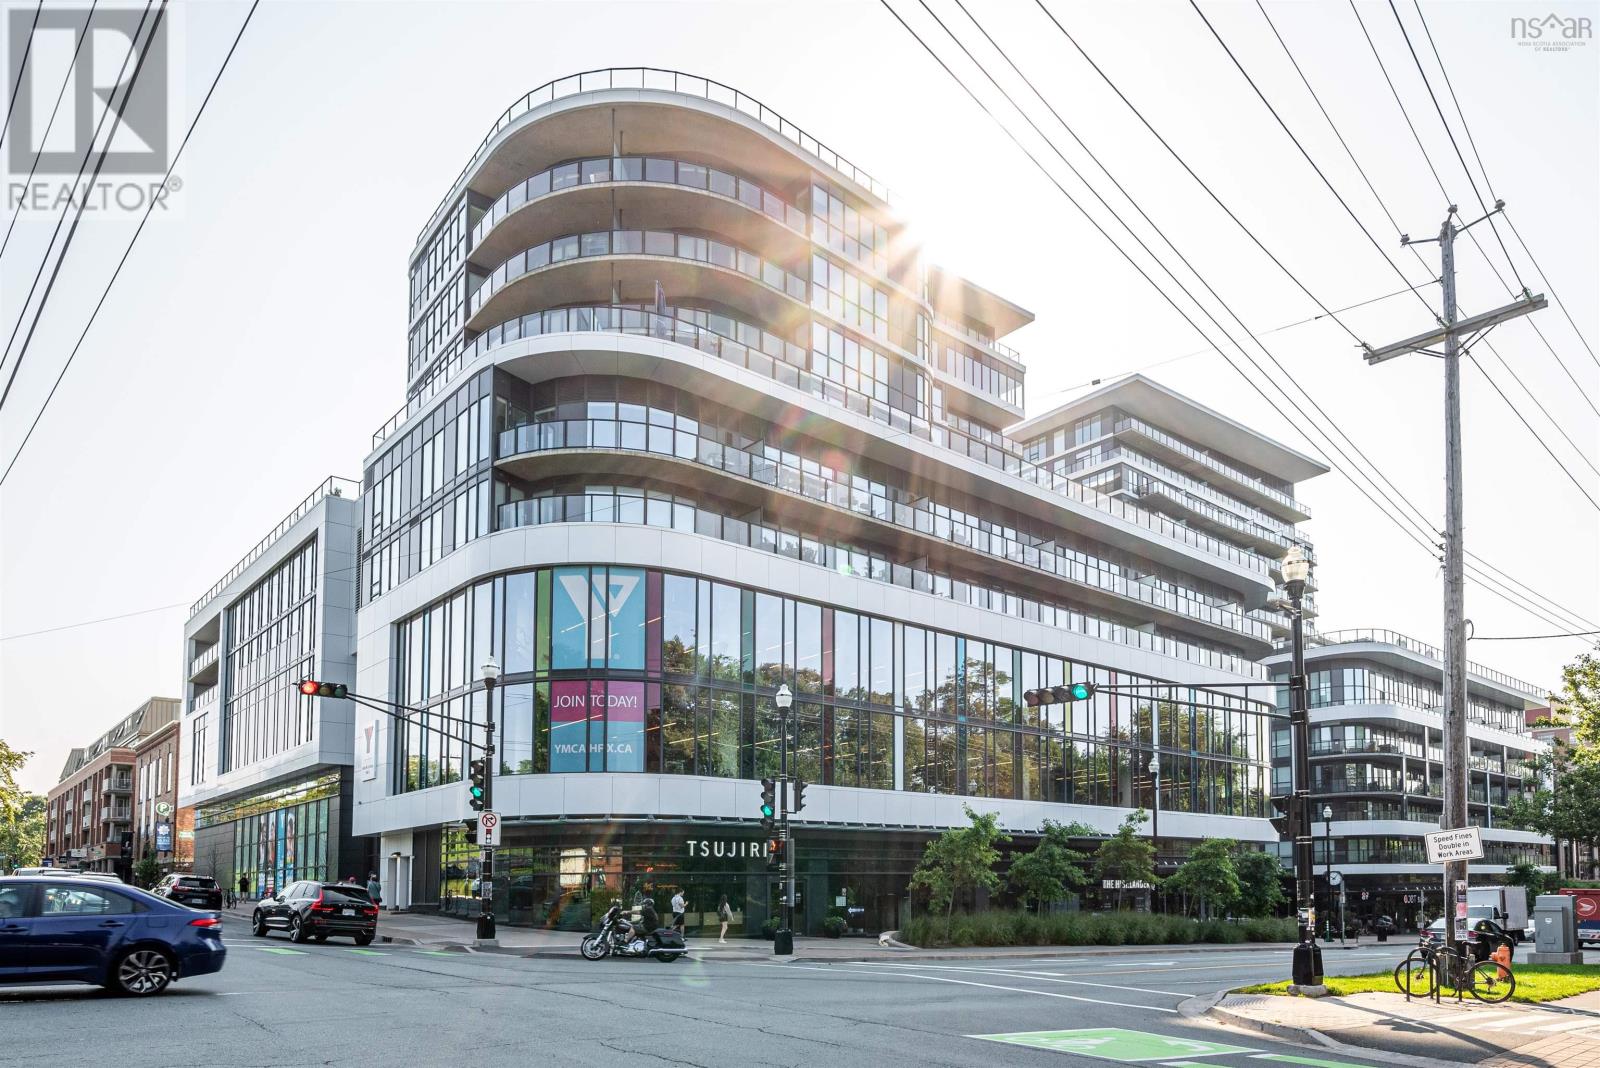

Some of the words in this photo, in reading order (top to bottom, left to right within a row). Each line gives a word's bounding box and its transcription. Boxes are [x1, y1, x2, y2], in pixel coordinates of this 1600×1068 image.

[553, 695, 585, 708] JOIN
[590, 694, 637, 708] TODAY!
[1433, 835, 1453, 843] Speed
[686, 841, 768, 857] TSUJIRI
[1438, 842, 1461, 850] Double
[1102, 879, 1114, 889] THE
